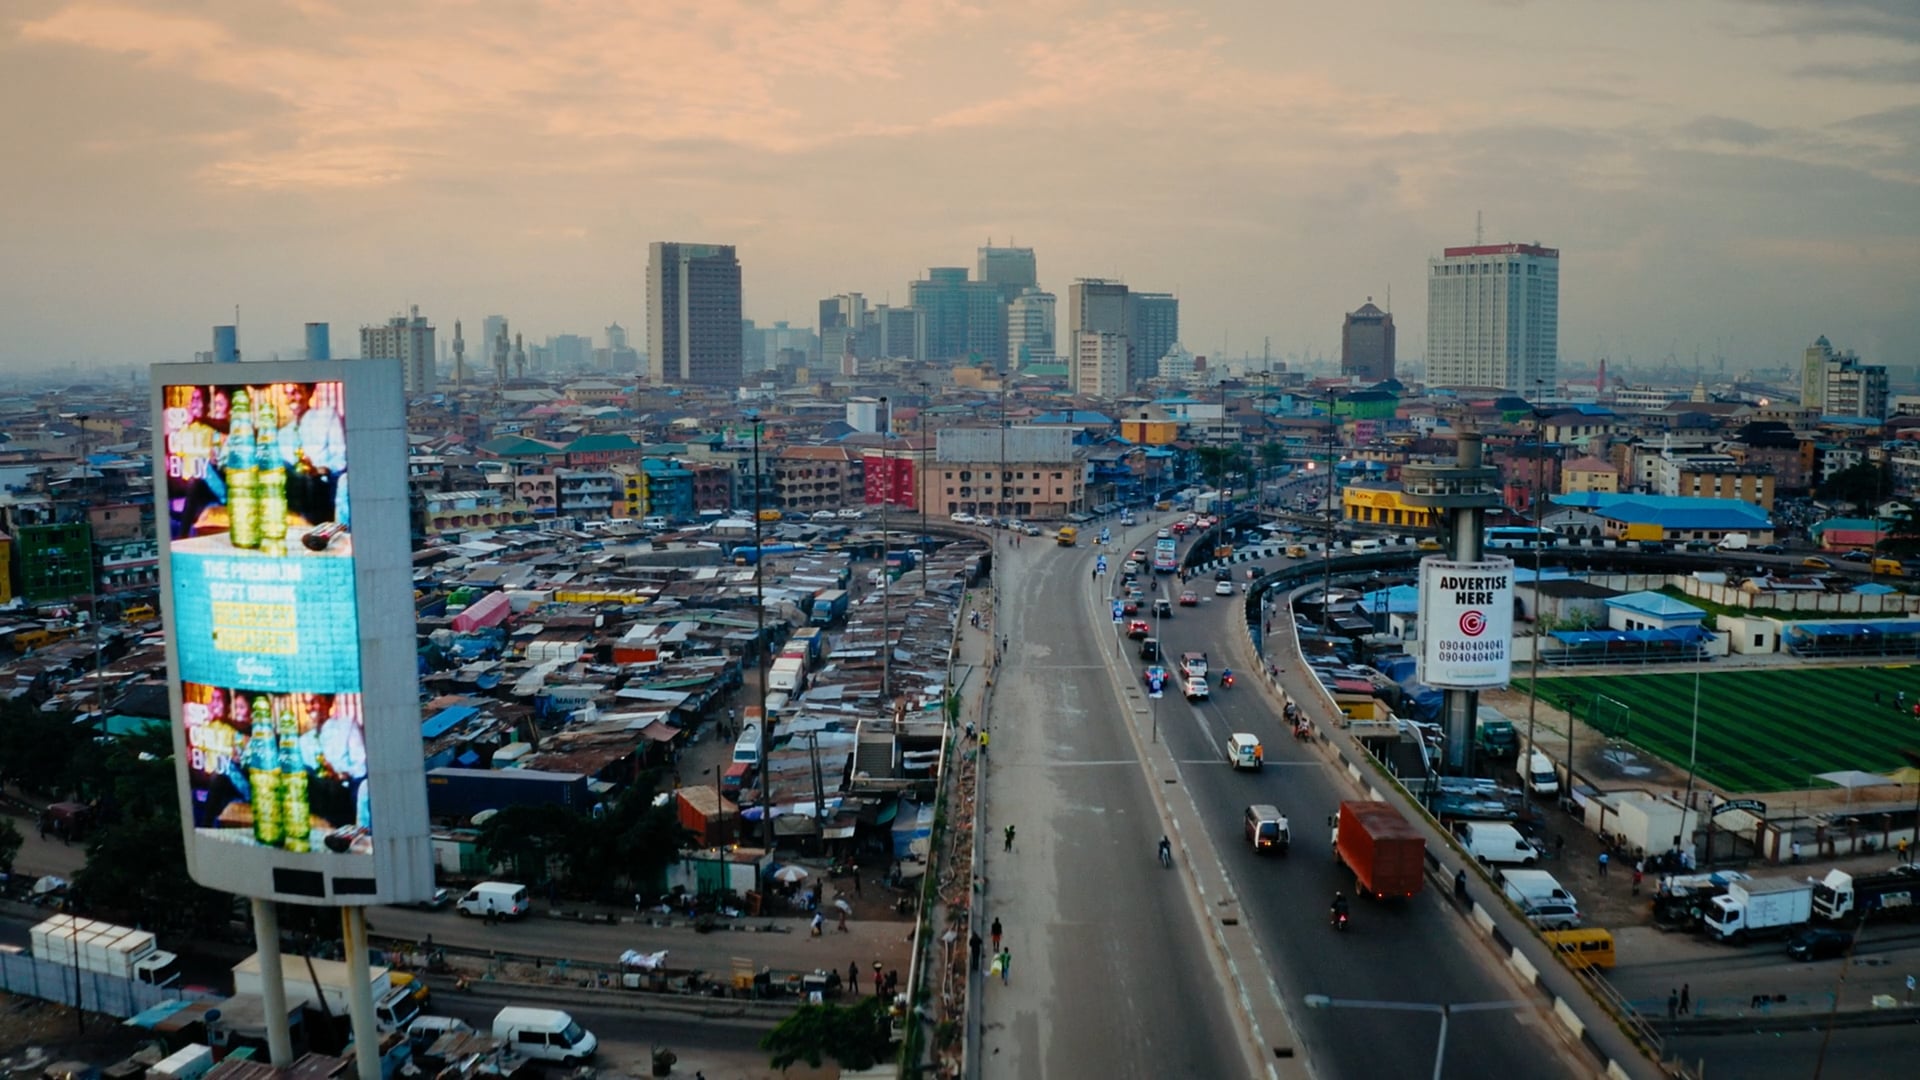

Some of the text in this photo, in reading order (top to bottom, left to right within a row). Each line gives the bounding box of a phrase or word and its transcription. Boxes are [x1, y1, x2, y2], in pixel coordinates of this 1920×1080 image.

[203, 560, 302, 581] THE PREMIUM
[1440, 576, 1507, 590] ADVERTISE
[1455, 592, 1494, 605] HERE
[1439, 640, 1504, 651] 09040404041
[556, 697, 587, 705] MAERS
